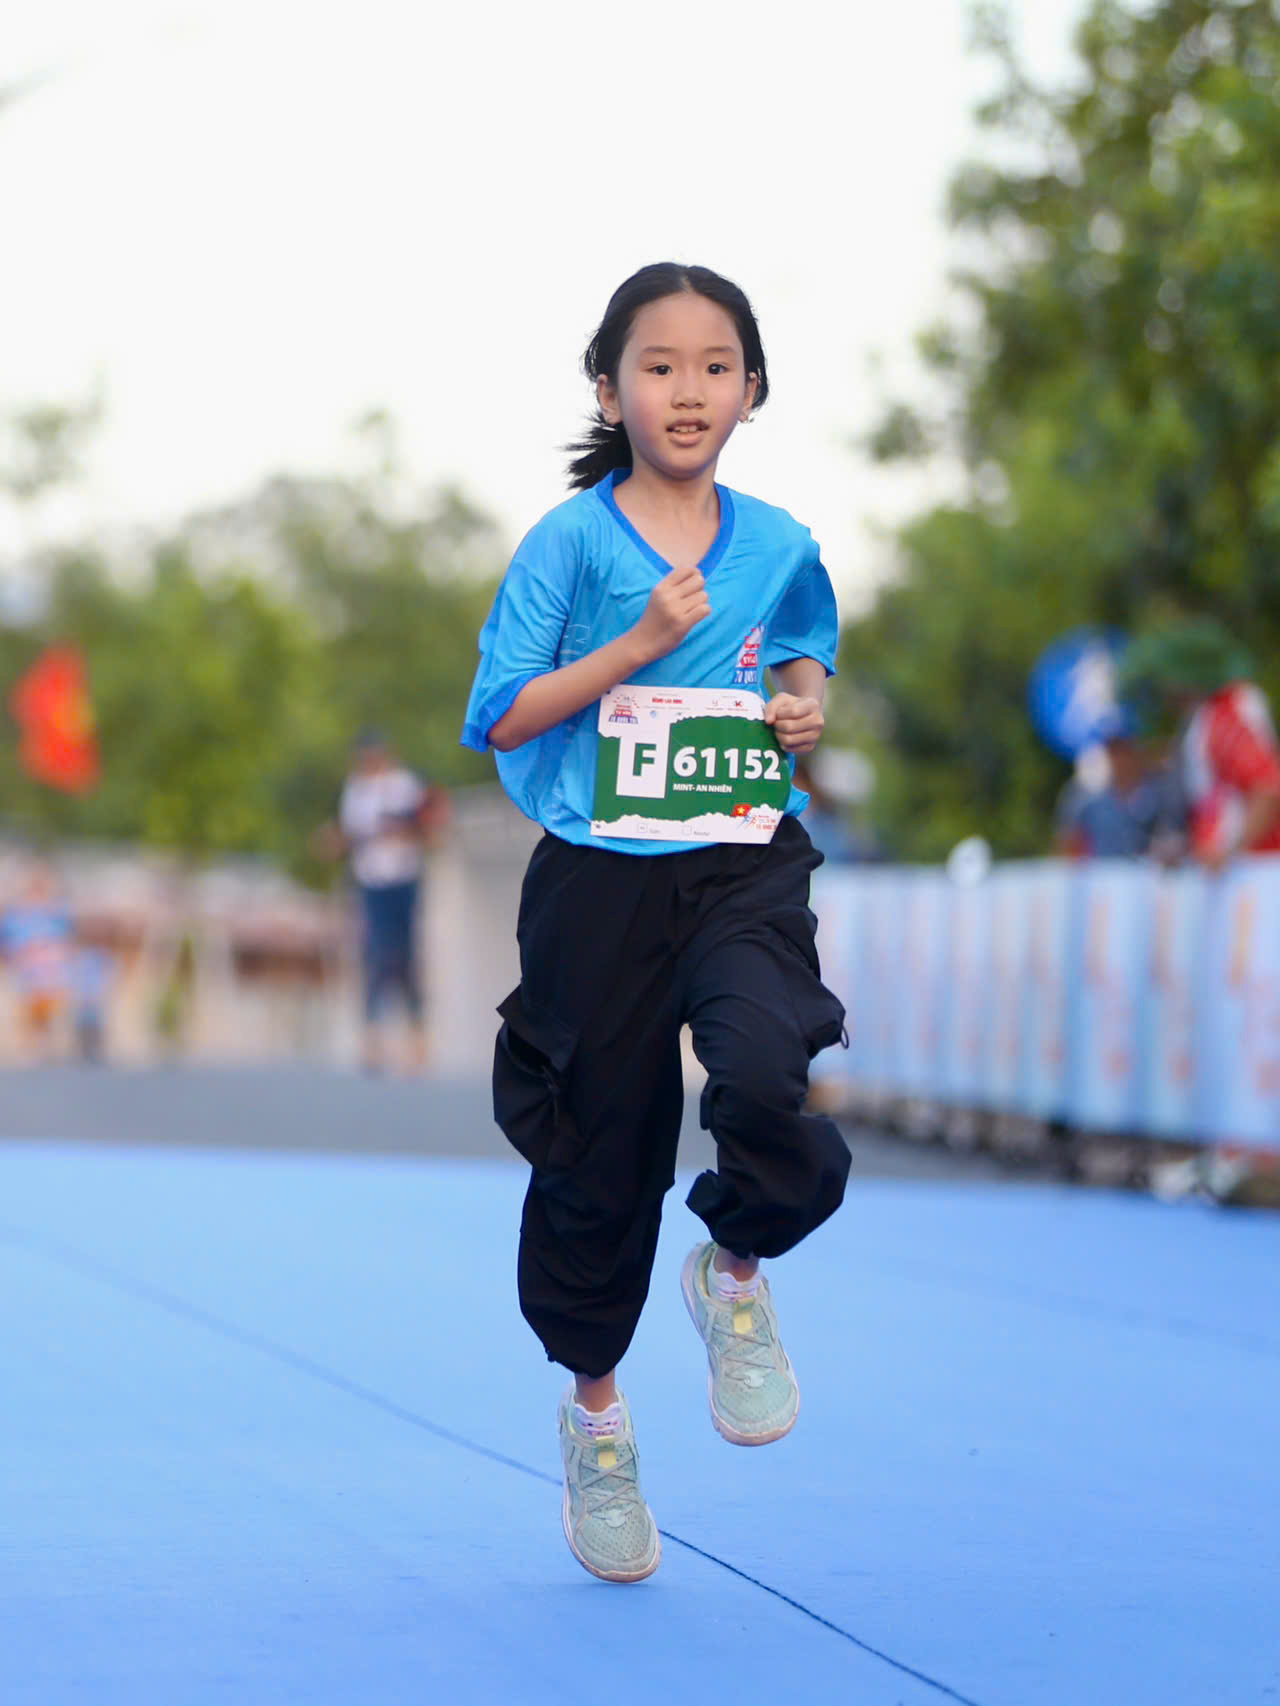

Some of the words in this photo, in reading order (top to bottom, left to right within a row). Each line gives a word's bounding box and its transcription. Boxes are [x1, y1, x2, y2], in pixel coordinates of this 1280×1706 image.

[632, 742, 657, 777] F
[673, 745, 781, 780] 61152
[696, 784, 707, 793] AN
[707, 783, 732, 793] NHIÊN
